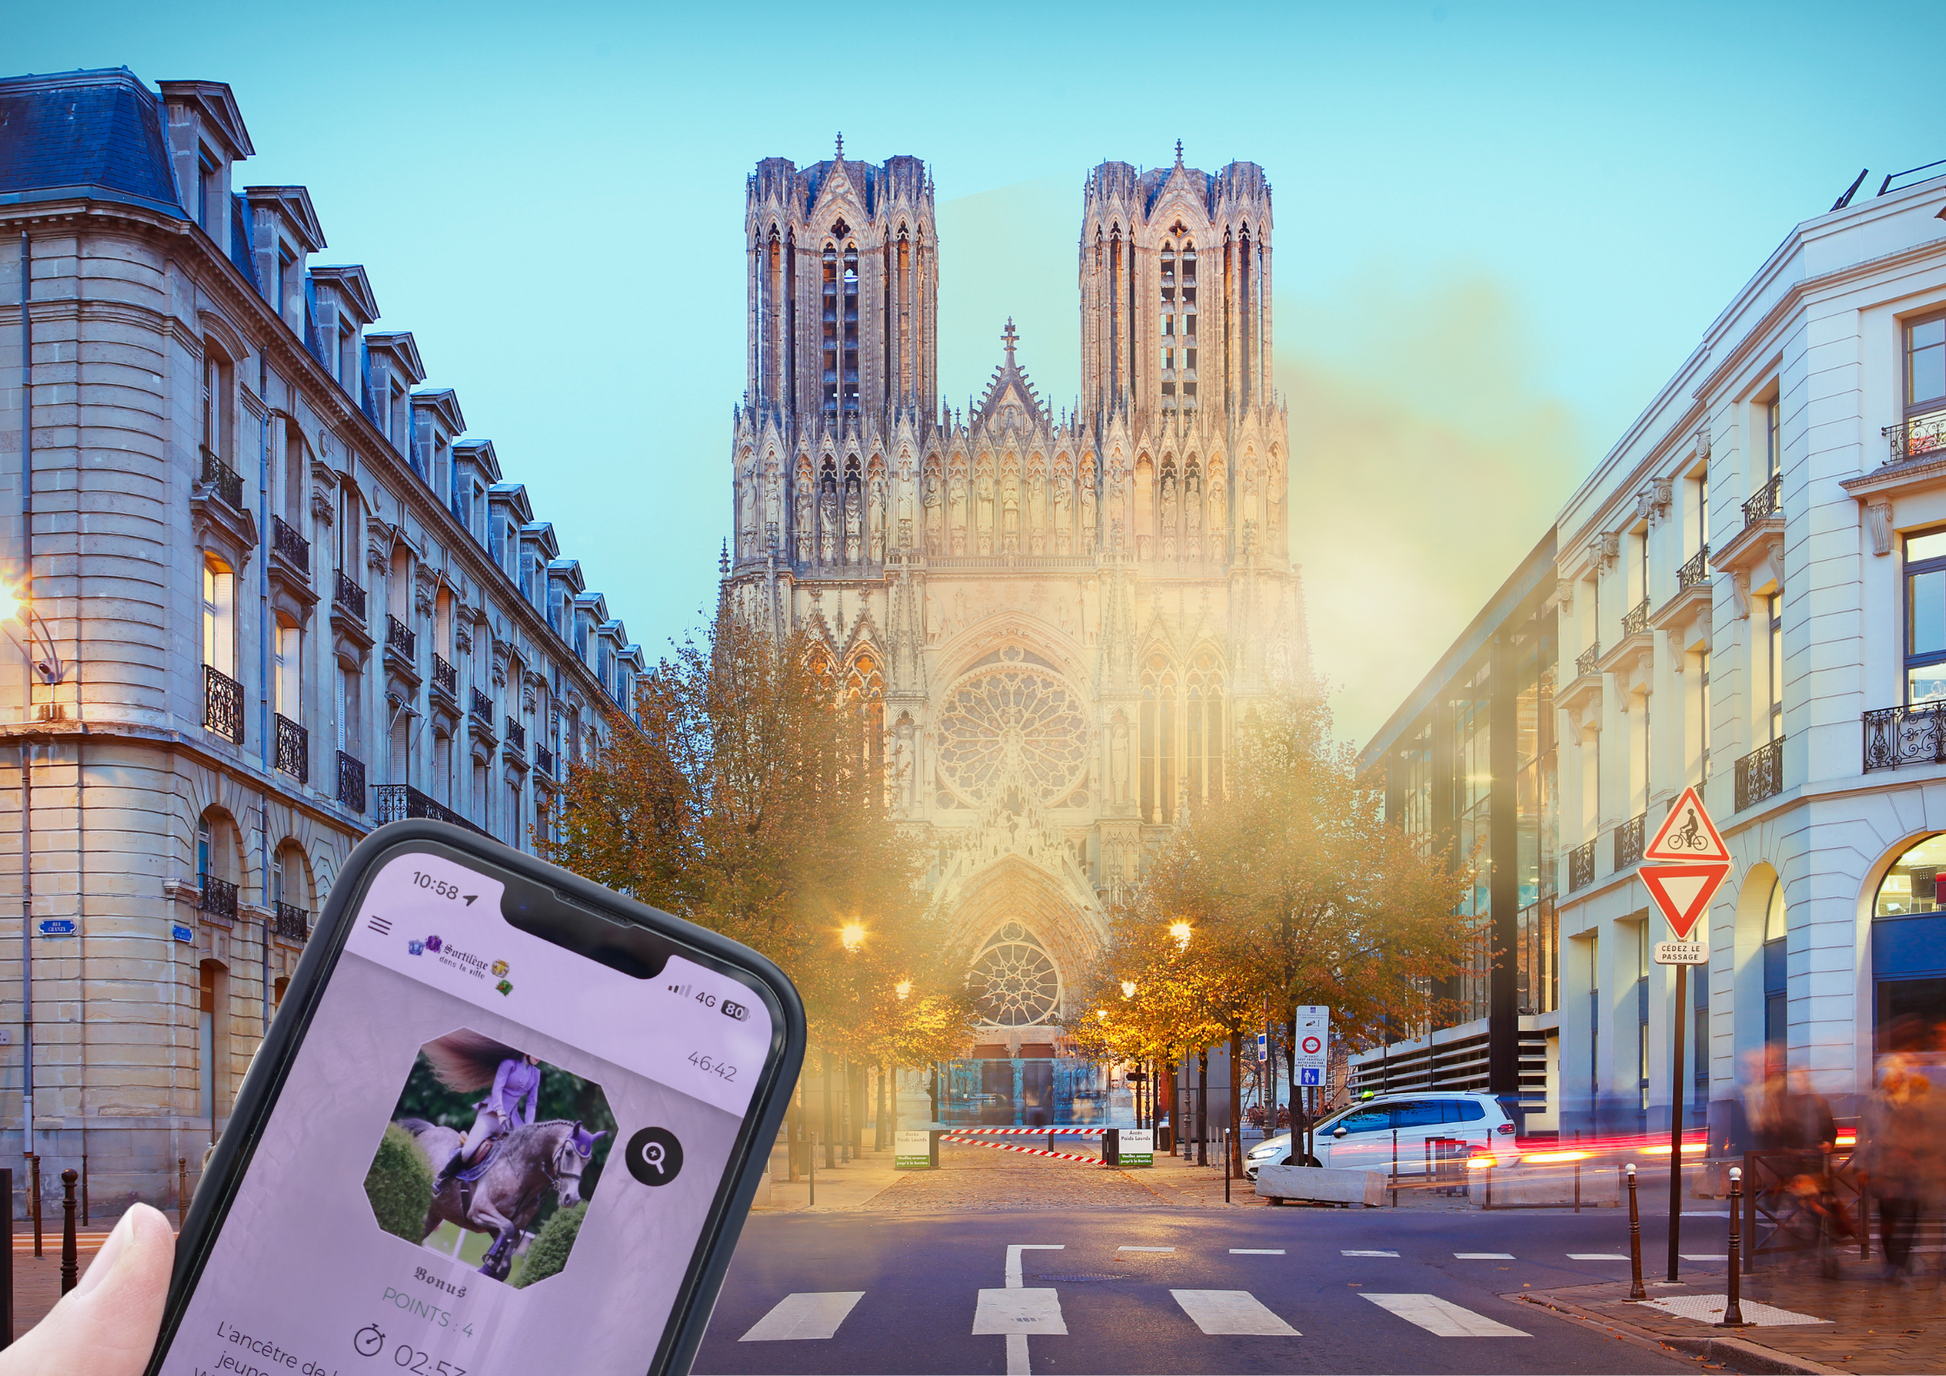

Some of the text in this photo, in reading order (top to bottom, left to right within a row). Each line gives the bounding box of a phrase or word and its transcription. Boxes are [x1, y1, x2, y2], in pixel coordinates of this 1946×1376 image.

[413, 871, 459, 900] 10:58
[444, 944, 489, 971] Sortilège
[1661, 944, 1687, 952] CÉDEZ
[439, 956, 485, 980] dans la ville
[695, 991, 717, 1008] 4G
[725, 1003, 745, 1019] 80
[687, 1051, 737, 1083] 46:42
[413, 1266, 467, 1298] Bonus
[382, 1286, 451, 1327] POINTS
[462, 1322, 473, 1338] 4
[216, 1321, 297, 1369] L'ancêtre
[214, 1350, 269, 1376] jeun
